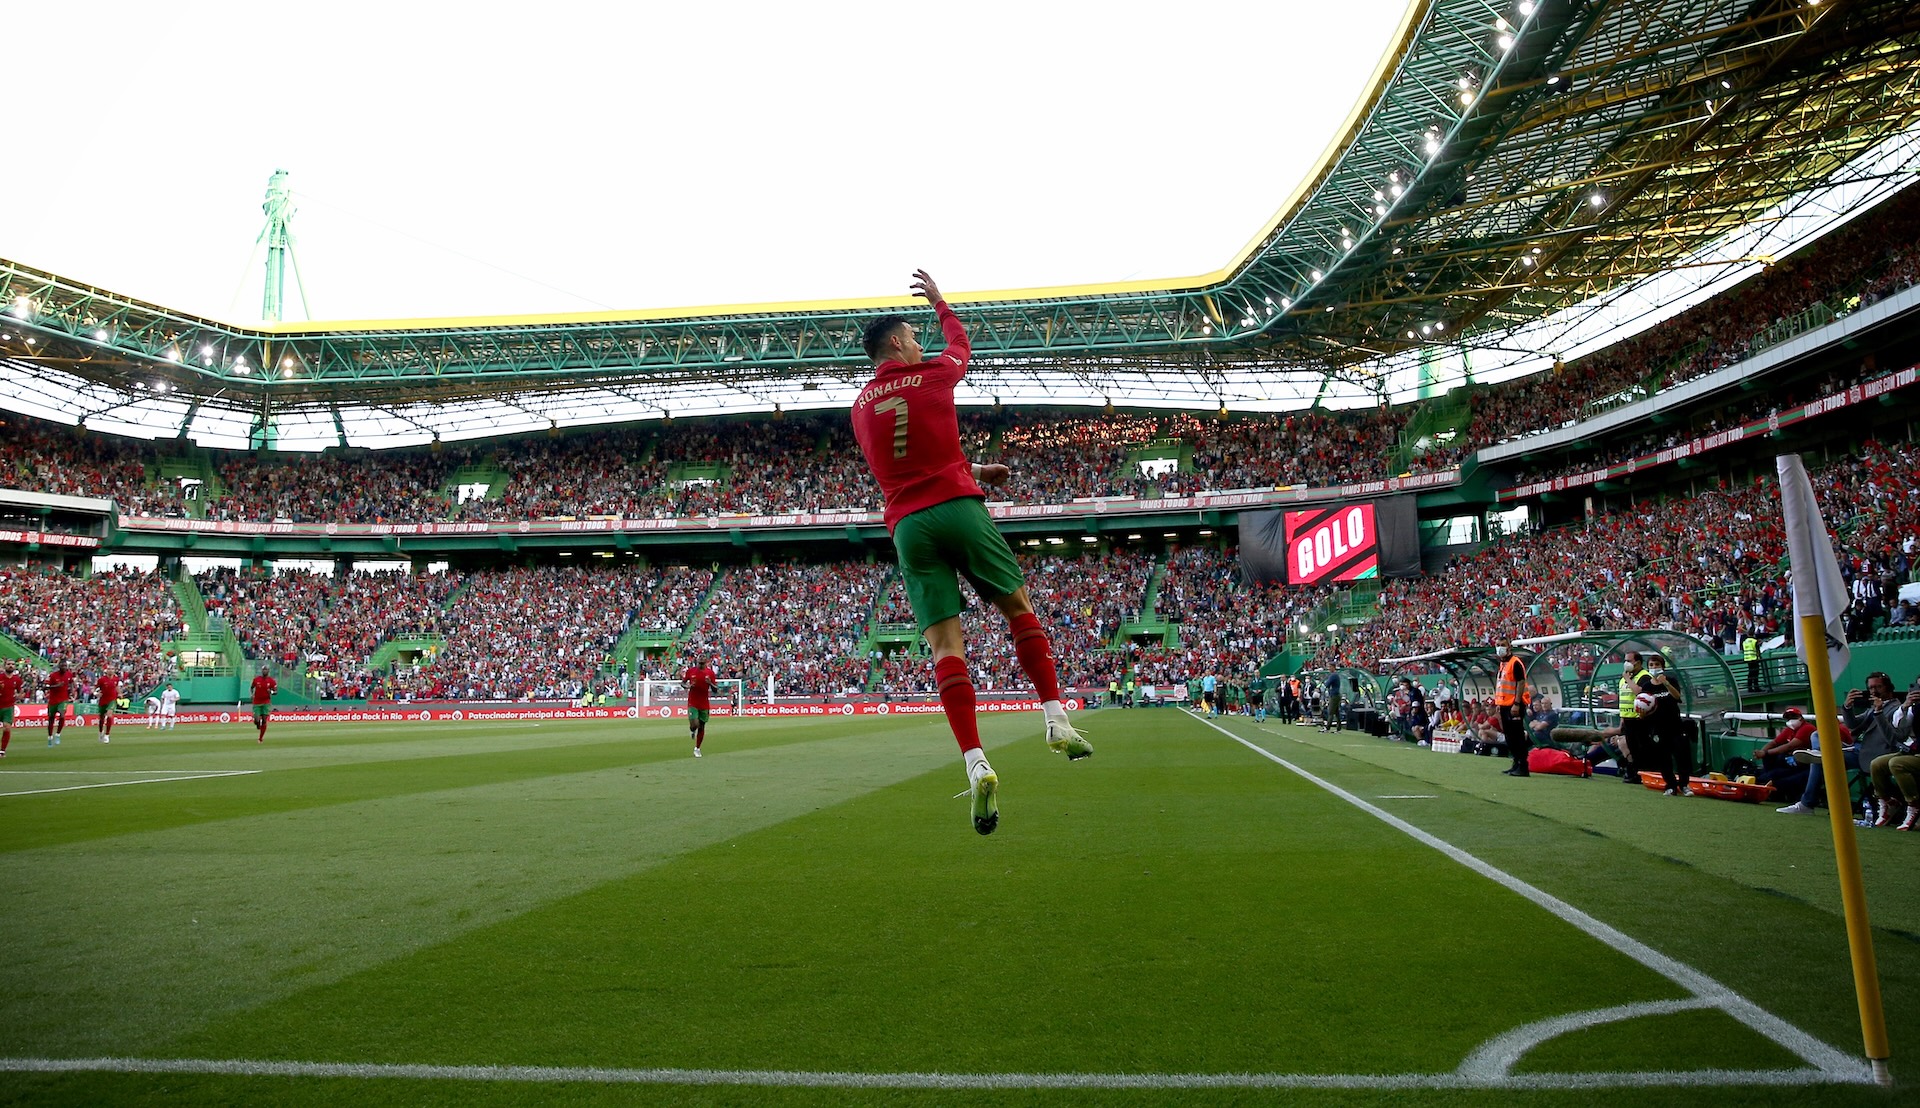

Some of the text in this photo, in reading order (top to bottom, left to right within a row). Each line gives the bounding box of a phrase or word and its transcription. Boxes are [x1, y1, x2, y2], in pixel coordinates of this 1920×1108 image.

[1865, 380, 1882, 398] VAMOS
[1896, 367, 1916, 387] TUDO
[858, 375, 922, 409] RONALDO
[1804, 392, 1846, 418] VAMOS TODOS
[874, 396, 908, 459] 7
[1403, 476, 1421, 487] VAMOS
[1434, 471, 1454, 483] TUDO
[1342, 481, 1385, 495] VAMOS TODOS
[1516, 481, 1552, 497] VAMOS TODOS
[1140, 498, 1189, 509] VAMOS TODOS
[1210, 496, 1229, 505] VAMOS
[1242, 493, 1263, 503] TUDO
[1010, 507, 1029, 515] VAMOS
[1042, 505, 1064, 514] TUDO
[750, 516, 796, 525] VAMOS TODOS
[816, 514, 834, 523] VAMOS
[848, 513, 868, 522] TUDO
[165, 519, 217, 530] VAMOS TODOS
[238, 523, 257, 532] VAMOS
[272, 524, 293, 533] TUDO
[371, 524, 418, 533] VAMOS TODOS
[437, 523, 455, 532] VAMOS
[468, 523, 488, 532] TUDO
[561, 520, 606, 530] VAMOS TODOS
[626, 520, 644, 529] VAMOS
[658, 519, 677, 528] TUDO
[0, 531, 22, 541] ODOS
[44, 534, 62, 544] VAMOS
[77, 537, 98, 547] TUDO
[1298, 507, 1364, 578] GOLO
[318, 713, 350, 722] principal
[520, 711, 553, 719] principal
[26, 718, 41, 726] Rock
